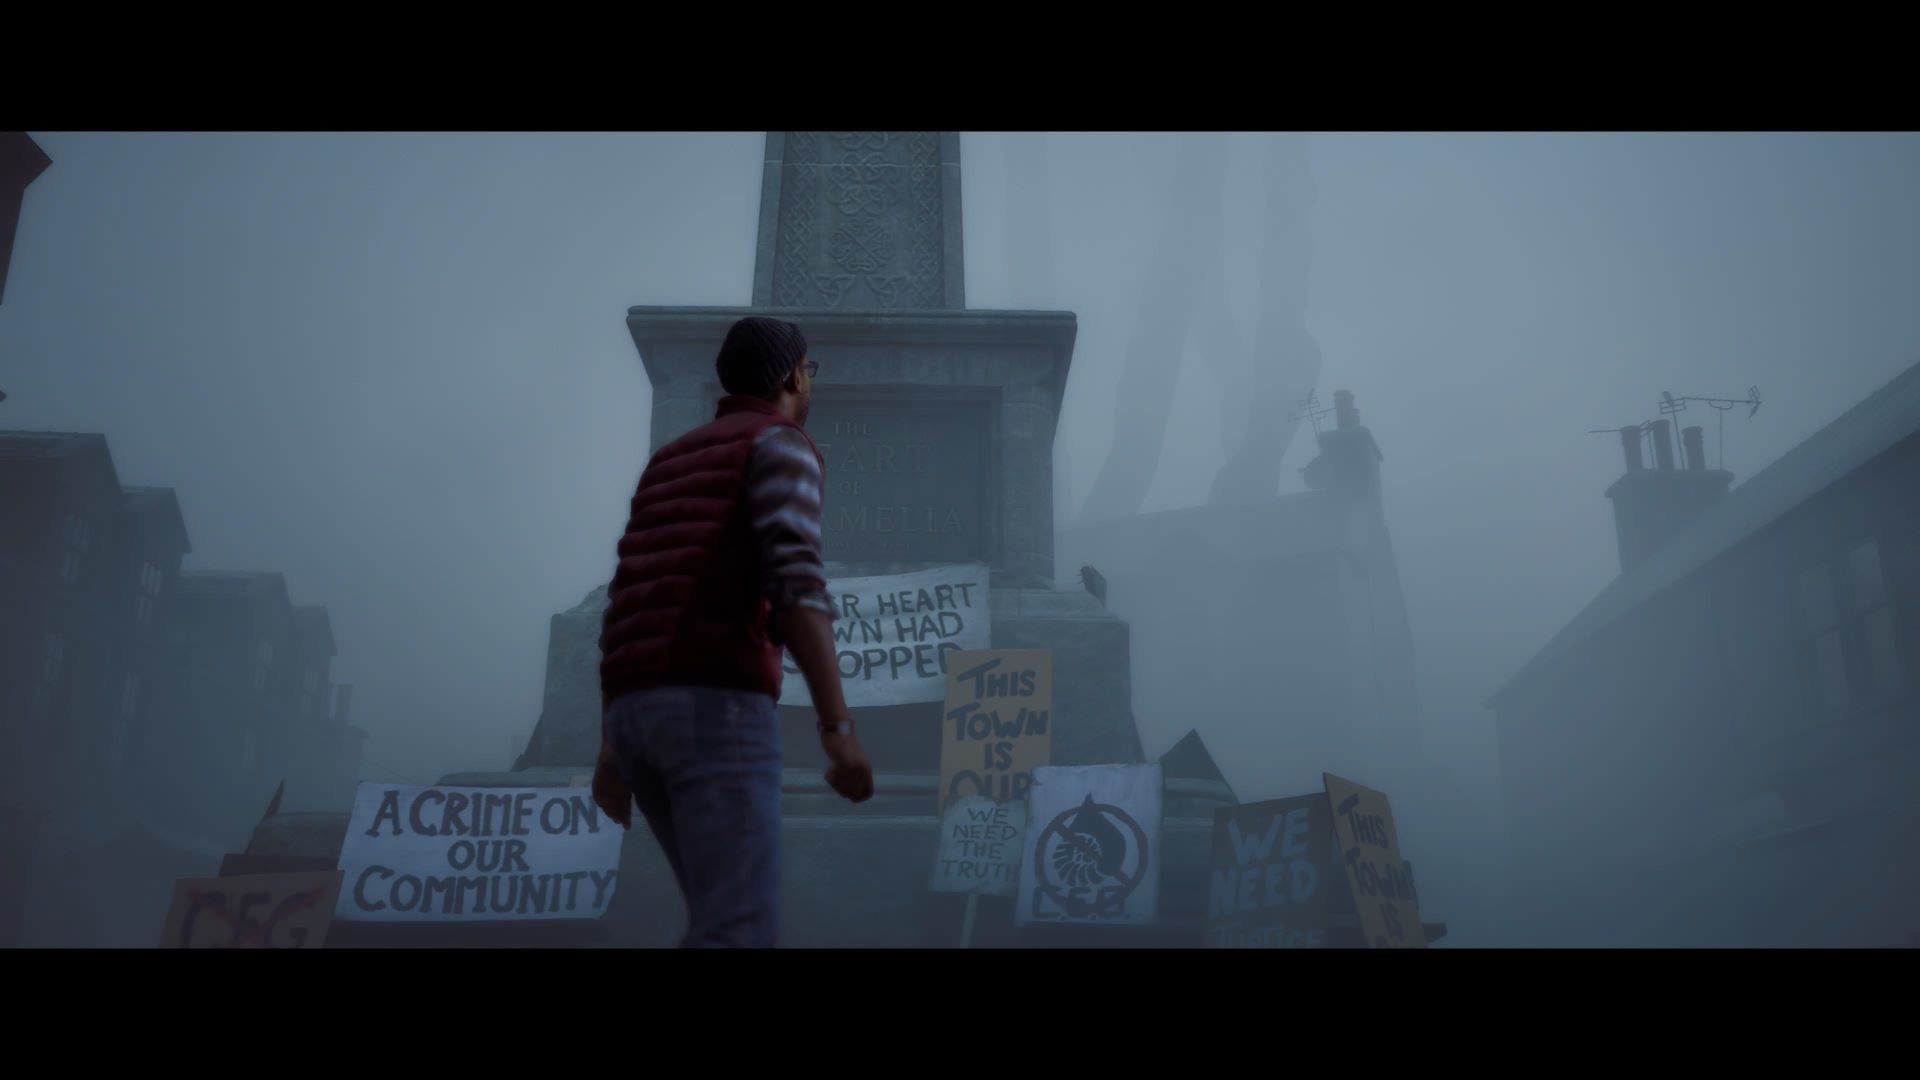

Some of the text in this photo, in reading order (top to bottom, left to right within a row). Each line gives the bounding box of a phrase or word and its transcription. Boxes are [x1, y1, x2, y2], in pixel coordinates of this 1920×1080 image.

[831, 421, 874, 436] THE
[877, 583, 977, 616] HEART
[895, 611, 964, 643] HAD
[956, 657, 1037, 699] THIS
[946, 702, 1049, 741] TOWN
[984, 741, 1014, 771] IS
[364, 789, 600, 838] A CRIME ON
[967, 807, 1009, 826] WE
[1337, 793, 1389, 849] THIS
[952, 823, 1018, 842] NEED
[1227, 807, 1310, 867] WE
[447, 840, 530, 873] OUR
[956, 839, 1005, 861] THE
[941, 859, 1021, 883] TRUTH
[353, 865, 618, 915] COMMUNITY
[1208, 858, 1320, 918] NEED
